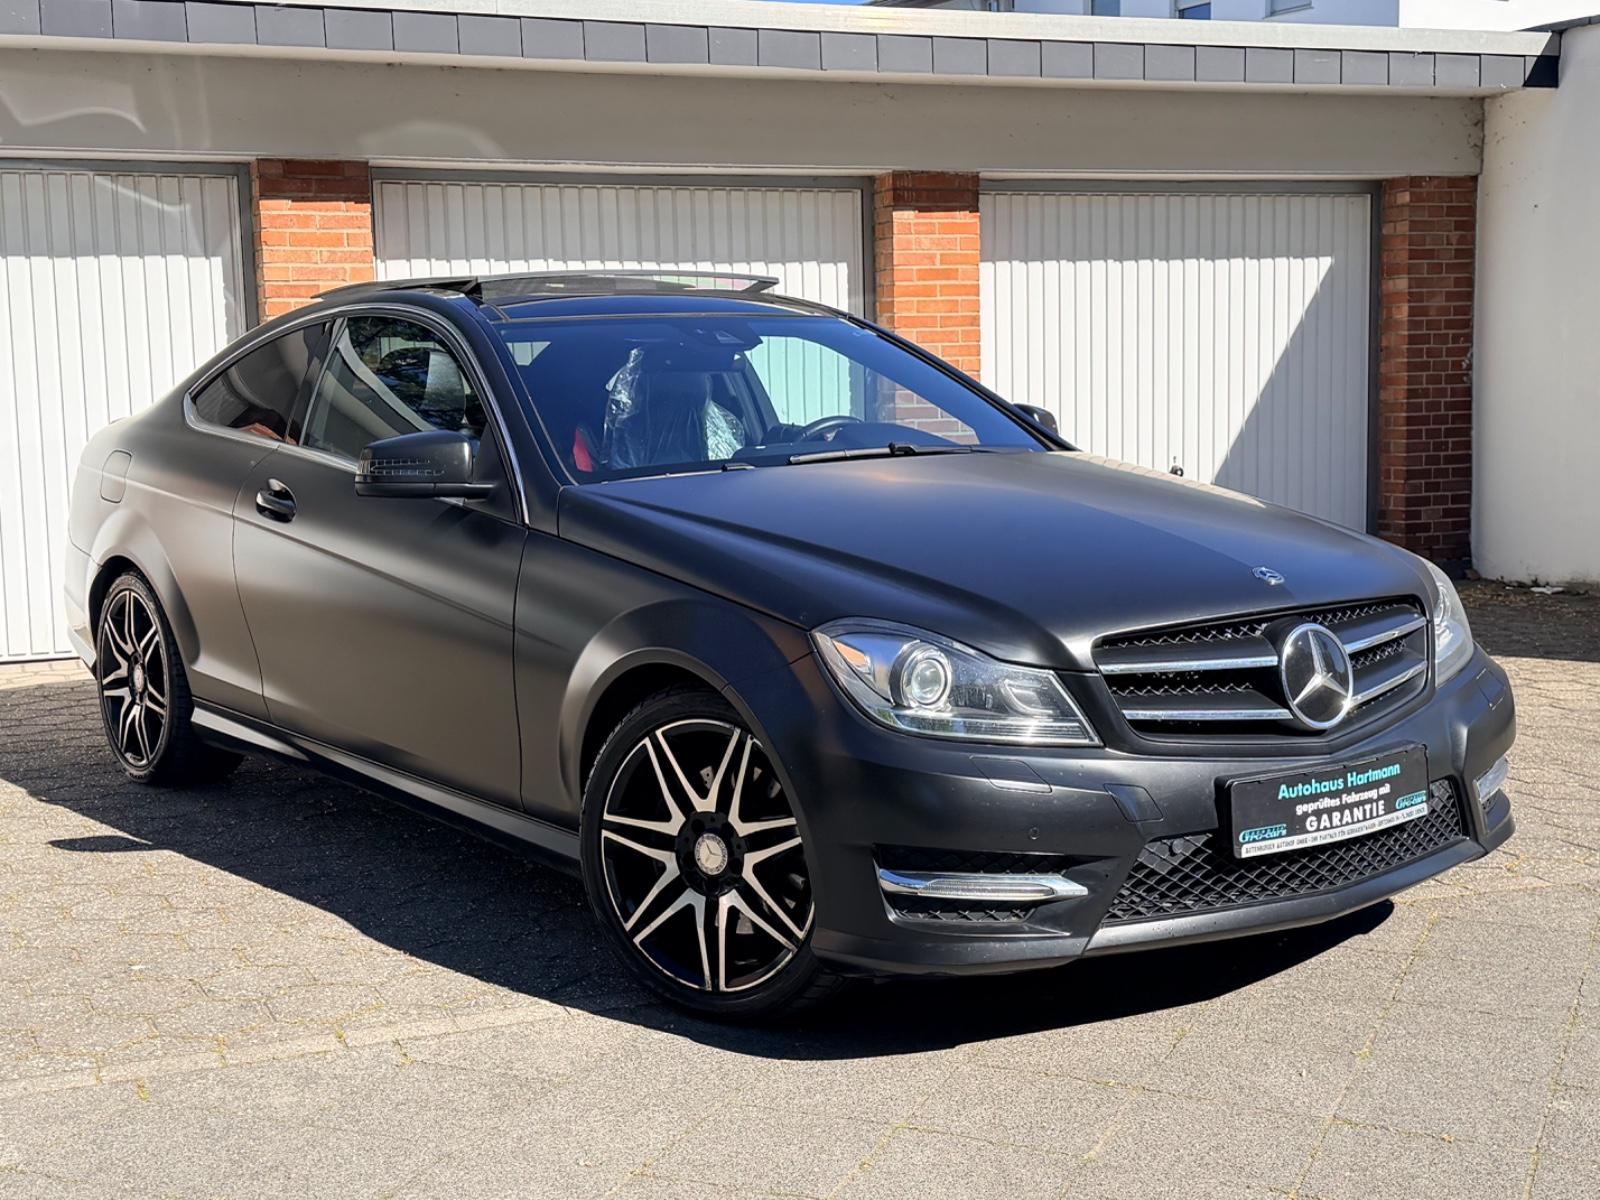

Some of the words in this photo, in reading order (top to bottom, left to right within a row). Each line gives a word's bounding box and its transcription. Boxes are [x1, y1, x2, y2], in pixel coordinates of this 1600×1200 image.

[1278, 779, 1344, 800] Autohaus
[1347, 764, 1400, 787] Hartmann
[1295, 798, 1340, 815] geprüftes
[1341, 788, 1378, 805] Fahrzeug
[1378, 783, 1391, 796] mit
[1305, 800, 1385, 831] GARANTIE
